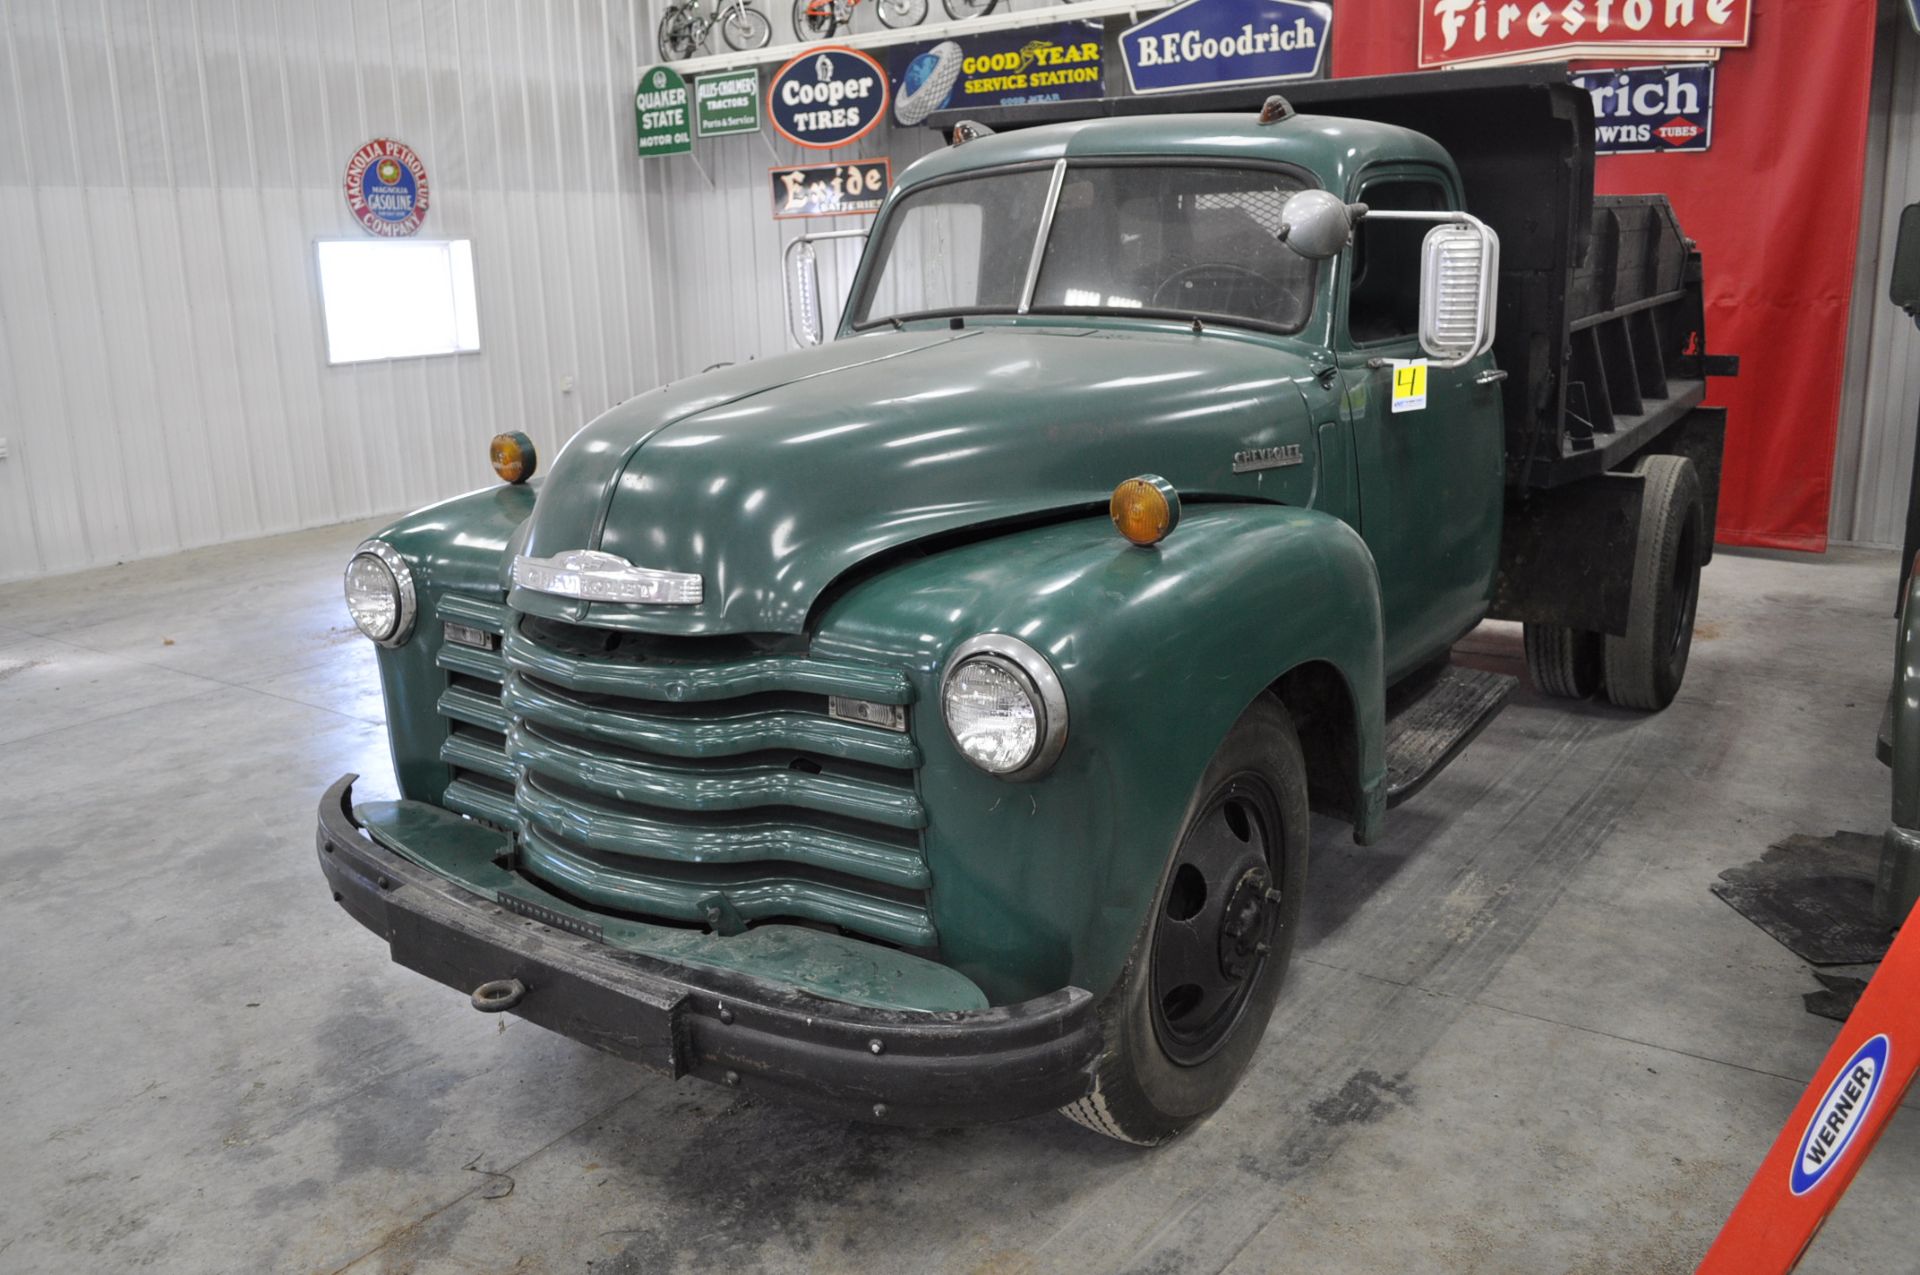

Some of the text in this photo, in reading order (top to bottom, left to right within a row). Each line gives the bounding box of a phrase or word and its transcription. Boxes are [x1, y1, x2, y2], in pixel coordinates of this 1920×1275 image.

[1434, 0, 1732, 51] Firestone
[1137, 18, 1316, 66] B.F.Goodrich
[782, 77, 873, 106] Cooper
[965, 67, 1098, 94] SERVICE STATION
[637, 88, 686, 111] QUAKER
[707, 97, 749, 110] TRACTORS
[1572, 73, 1700, 118] rich
[642, 109, 685, 129] STATE
[728, 116, 755, 126] Service
[794, 107, 860, 132] TIRES
[639, 133, 690, 148] MOTOR OIL
[1659, 126, 1698, 138] TUBES
[347, 142, 429, 210] MAGNOLIA PETROLEUM
[781, 165, 882, 210] Exide
[368, 193, 413, 210] GASOLINE
[363, 213, 420, 236] COMPANY
[1398, 368, 1416, 396] 4
[1234, 444, 1301, 463] CHEVROLET
[1806, 1065, 1871, 1165] WERNER
